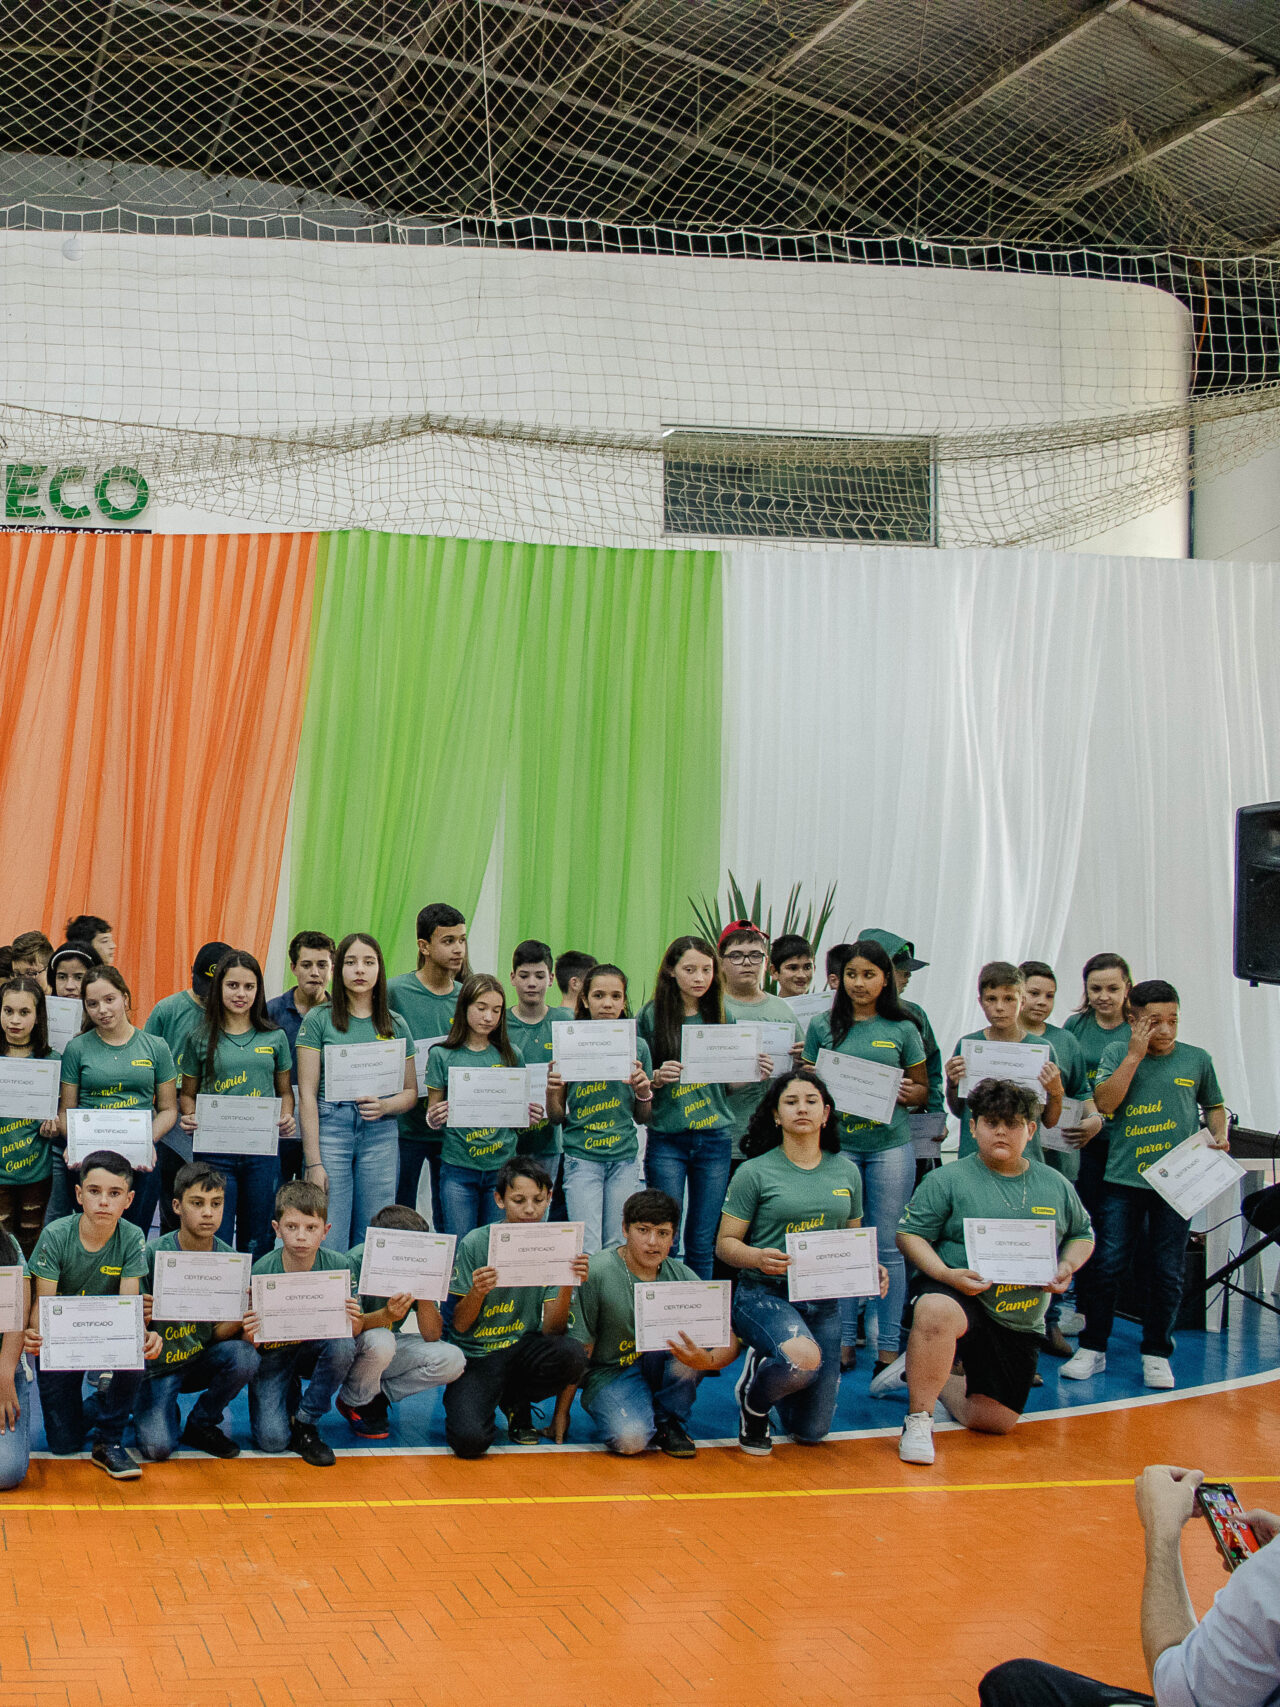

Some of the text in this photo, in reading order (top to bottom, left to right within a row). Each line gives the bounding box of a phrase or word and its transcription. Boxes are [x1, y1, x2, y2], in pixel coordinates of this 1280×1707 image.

[214, 1070, 247, 1092] Cotriel
[577, 1098, 620, 1119] Educando
[1126, 1100, 1162, 1117] Cotriel
[1125, 1119, 1176, 1137] Educando
[2, 1138, 33, 1158] para o
[469, 1140, 503, 1157] Campo
[585, 1133, 620, 1149] Campo
[1136, 1144, 1163, 1157] para
[6, 1151, 39, 1172] Campo
[996, 1298, 1039, 1312] Campo
